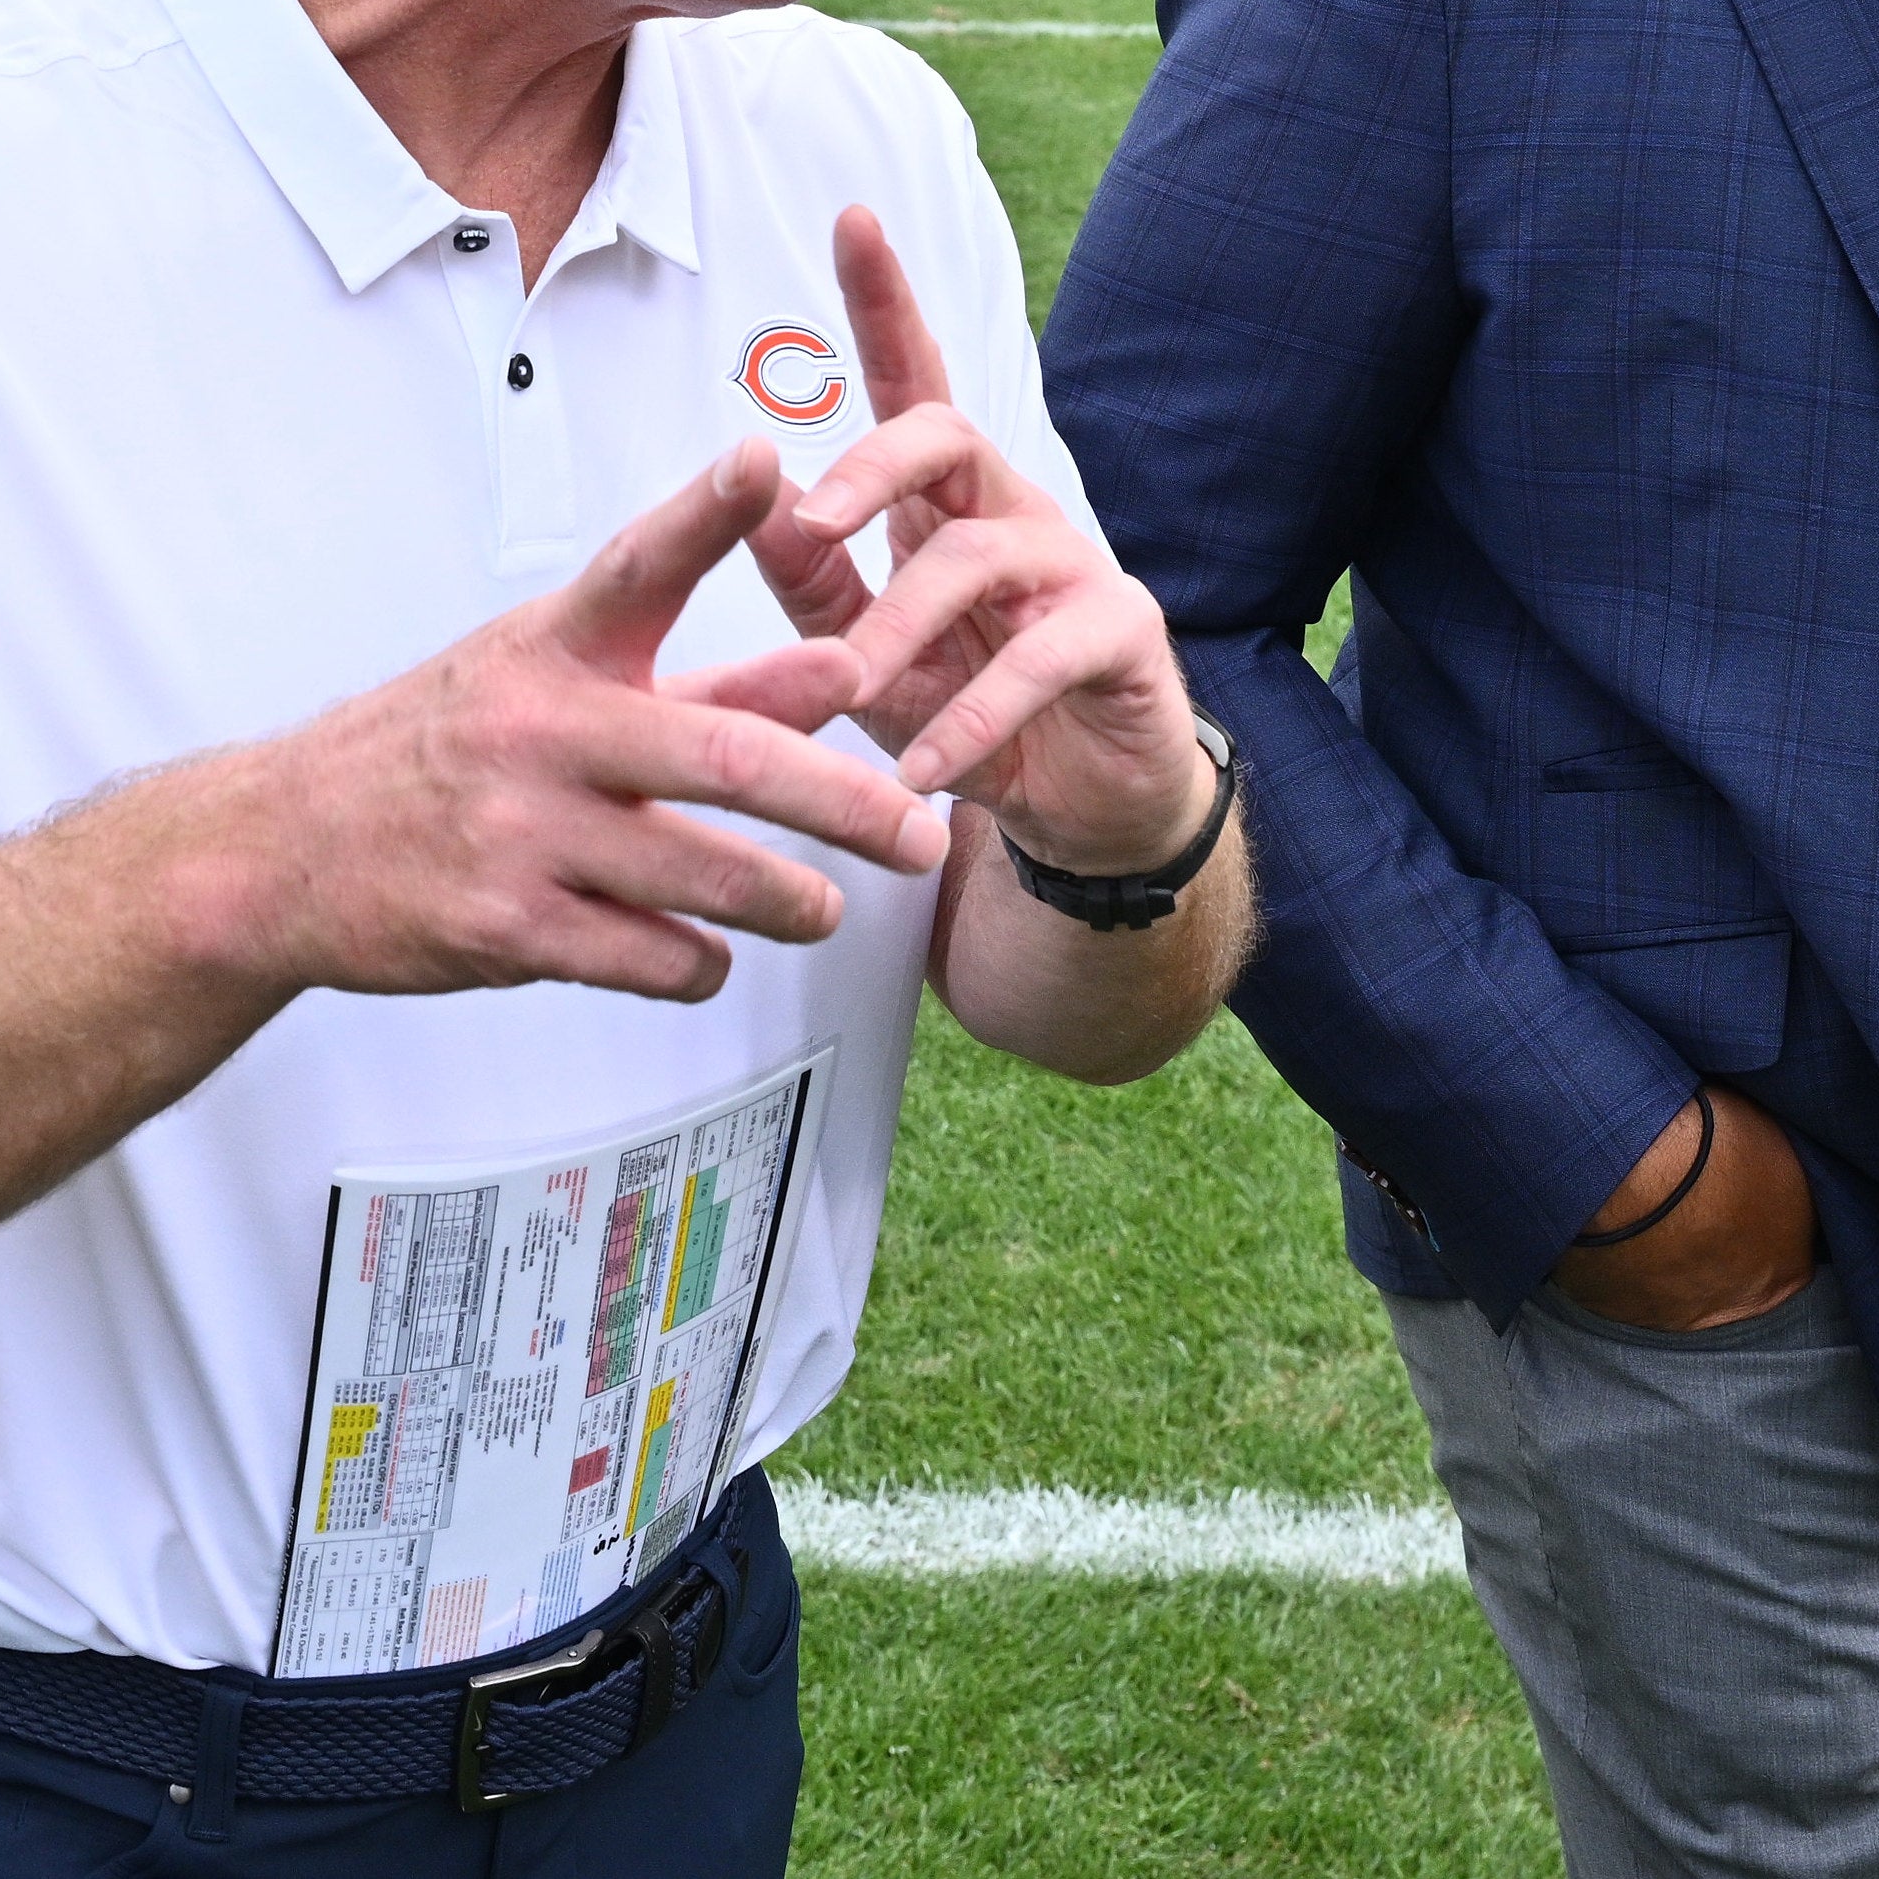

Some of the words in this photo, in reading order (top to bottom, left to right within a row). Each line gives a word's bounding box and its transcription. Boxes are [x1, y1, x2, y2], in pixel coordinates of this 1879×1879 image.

[387, 1391, 398, 1412] EOH
[380, 1411, 394, 1442] Scoring
[379, 1441, 390, 1465] Rates
